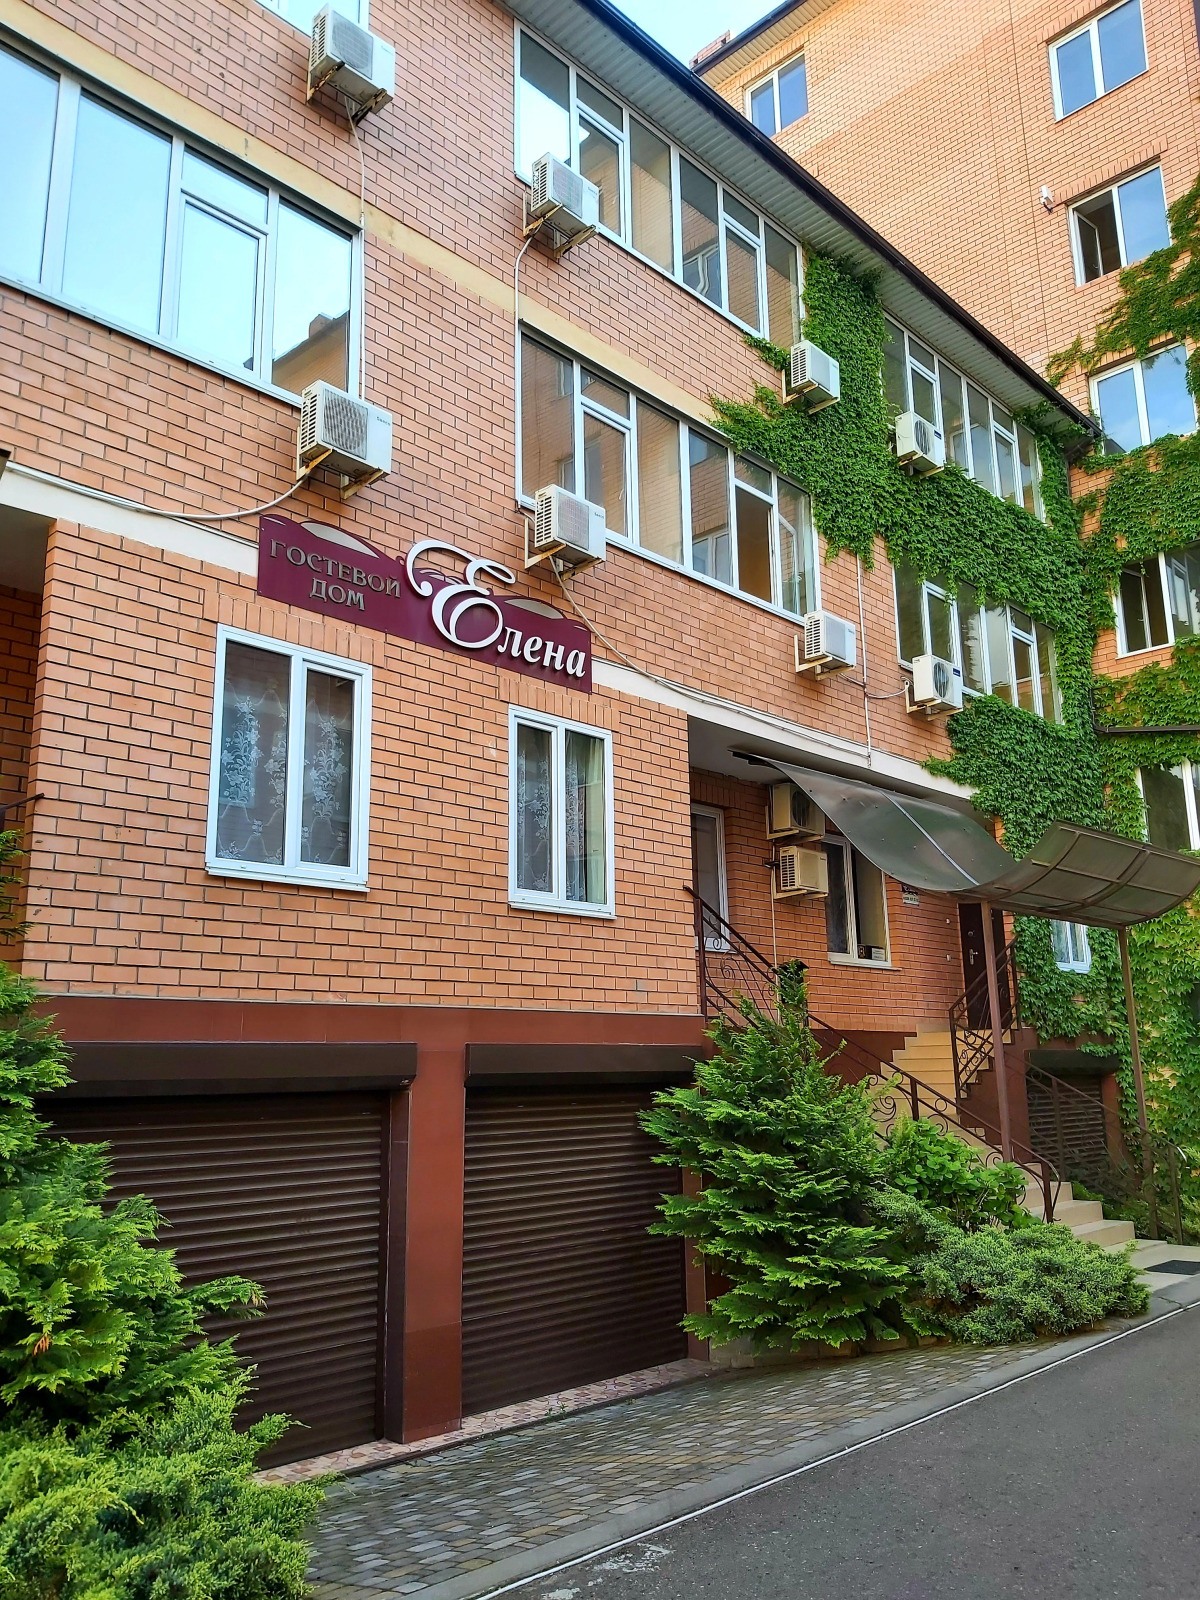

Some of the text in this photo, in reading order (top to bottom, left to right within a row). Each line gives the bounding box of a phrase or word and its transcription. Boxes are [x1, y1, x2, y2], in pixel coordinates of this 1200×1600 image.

[270, 538, 400, 598] ГОСТЕВОЙ
[309, 577, 366, 611] ДОМ
[406, 540, 586, 678] Елена
